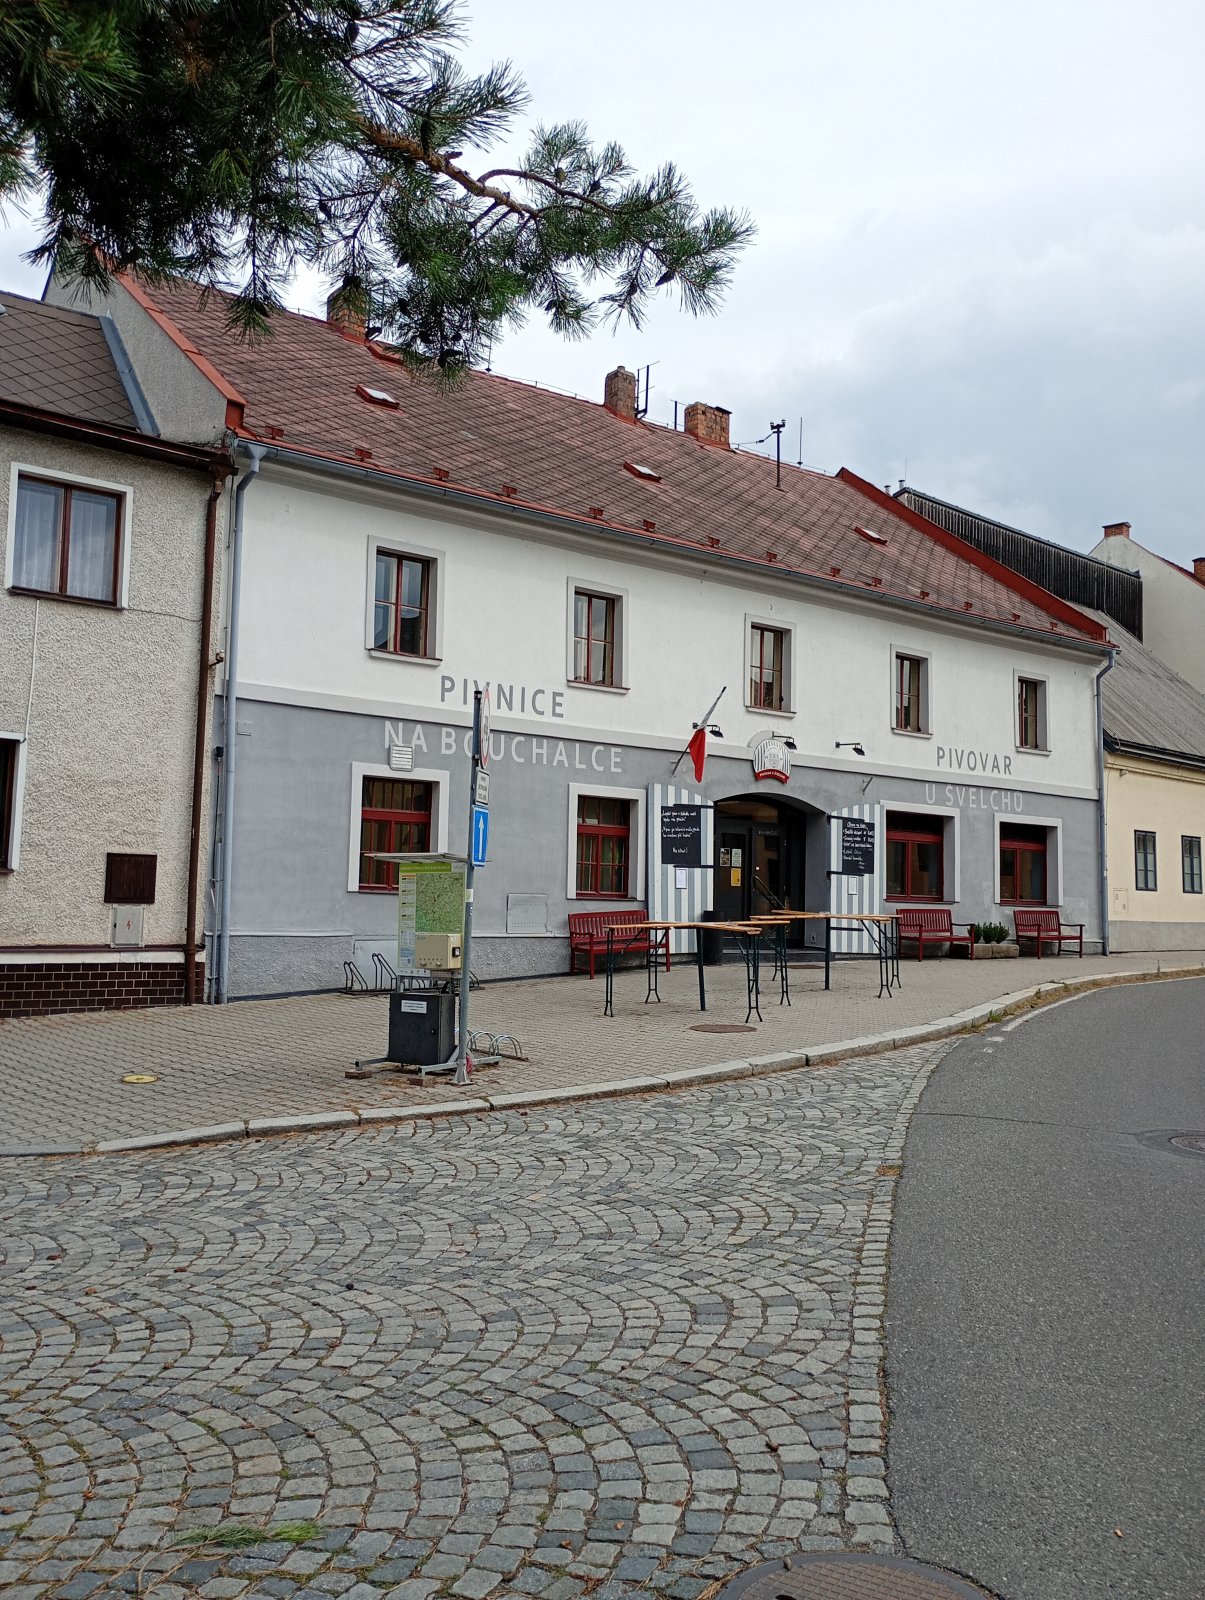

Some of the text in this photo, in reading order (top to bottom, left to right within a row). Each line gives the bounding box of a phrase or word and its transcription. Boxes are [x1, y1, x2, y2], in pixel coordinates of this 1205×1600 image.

[384, 720, 428, 753] NA
[936, 746, 1012, 776] PIVOVAR
[925, 783, 936, 805] U
